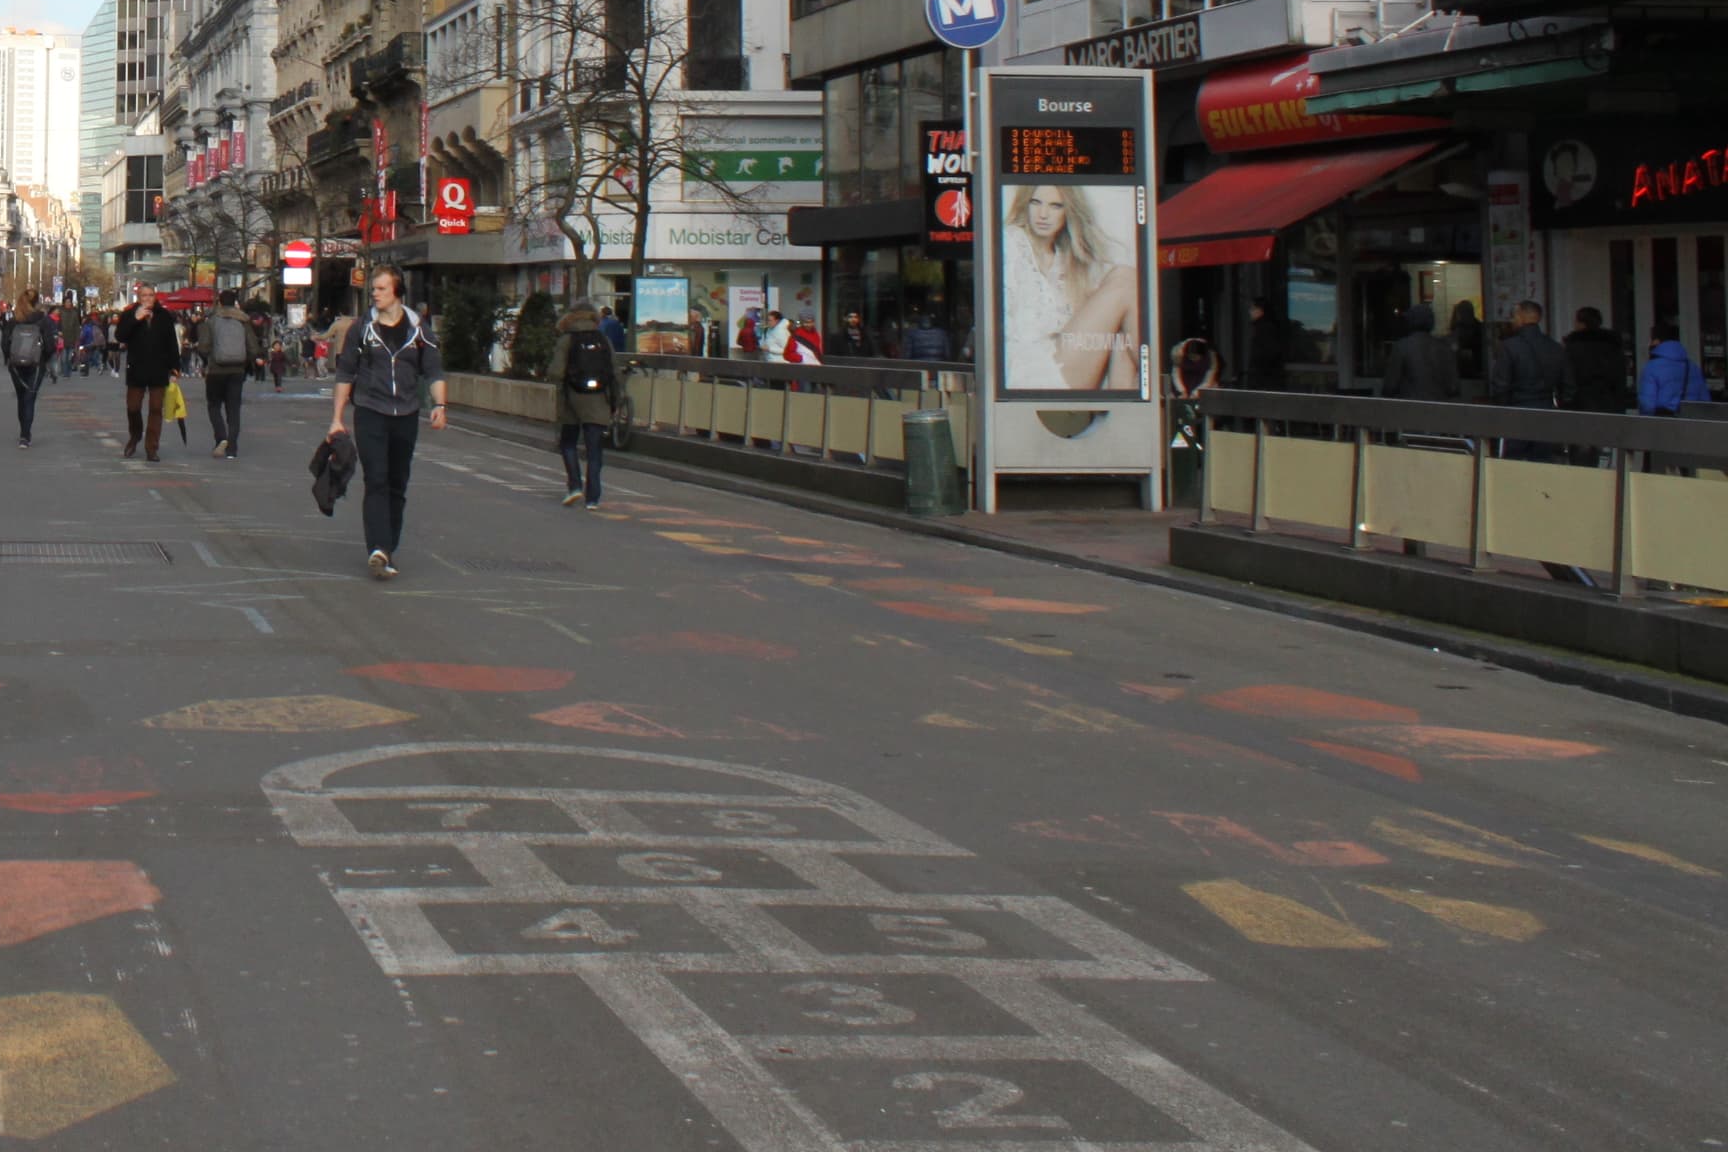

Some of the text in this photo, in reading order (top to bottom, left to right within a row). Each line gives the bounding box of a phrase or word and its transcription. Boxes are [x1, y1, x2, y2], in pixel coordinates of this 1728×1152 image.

[1068, 20, 1199, 68] MARC BARTIER
[1038, 98, 1093, 113] Bourse
[1208, 98, 1316, 139] SULTANS
[928, 130, 966, 152] THA
[443, 183, 467, 211] Q
[439, 218, 467, 228] Quick
[669, 227, 752, 246] Mobistar
[406, 801, 492, 829] 7
[702, 809, 799, 835] 8
[616, 852, 723, 882] 6
[519, 908, 640, 945] 4
[868, 912, 987, 949] 5
[780, 980, 917, 1027] 3
[890, 1071, 1070, 1129] 2
